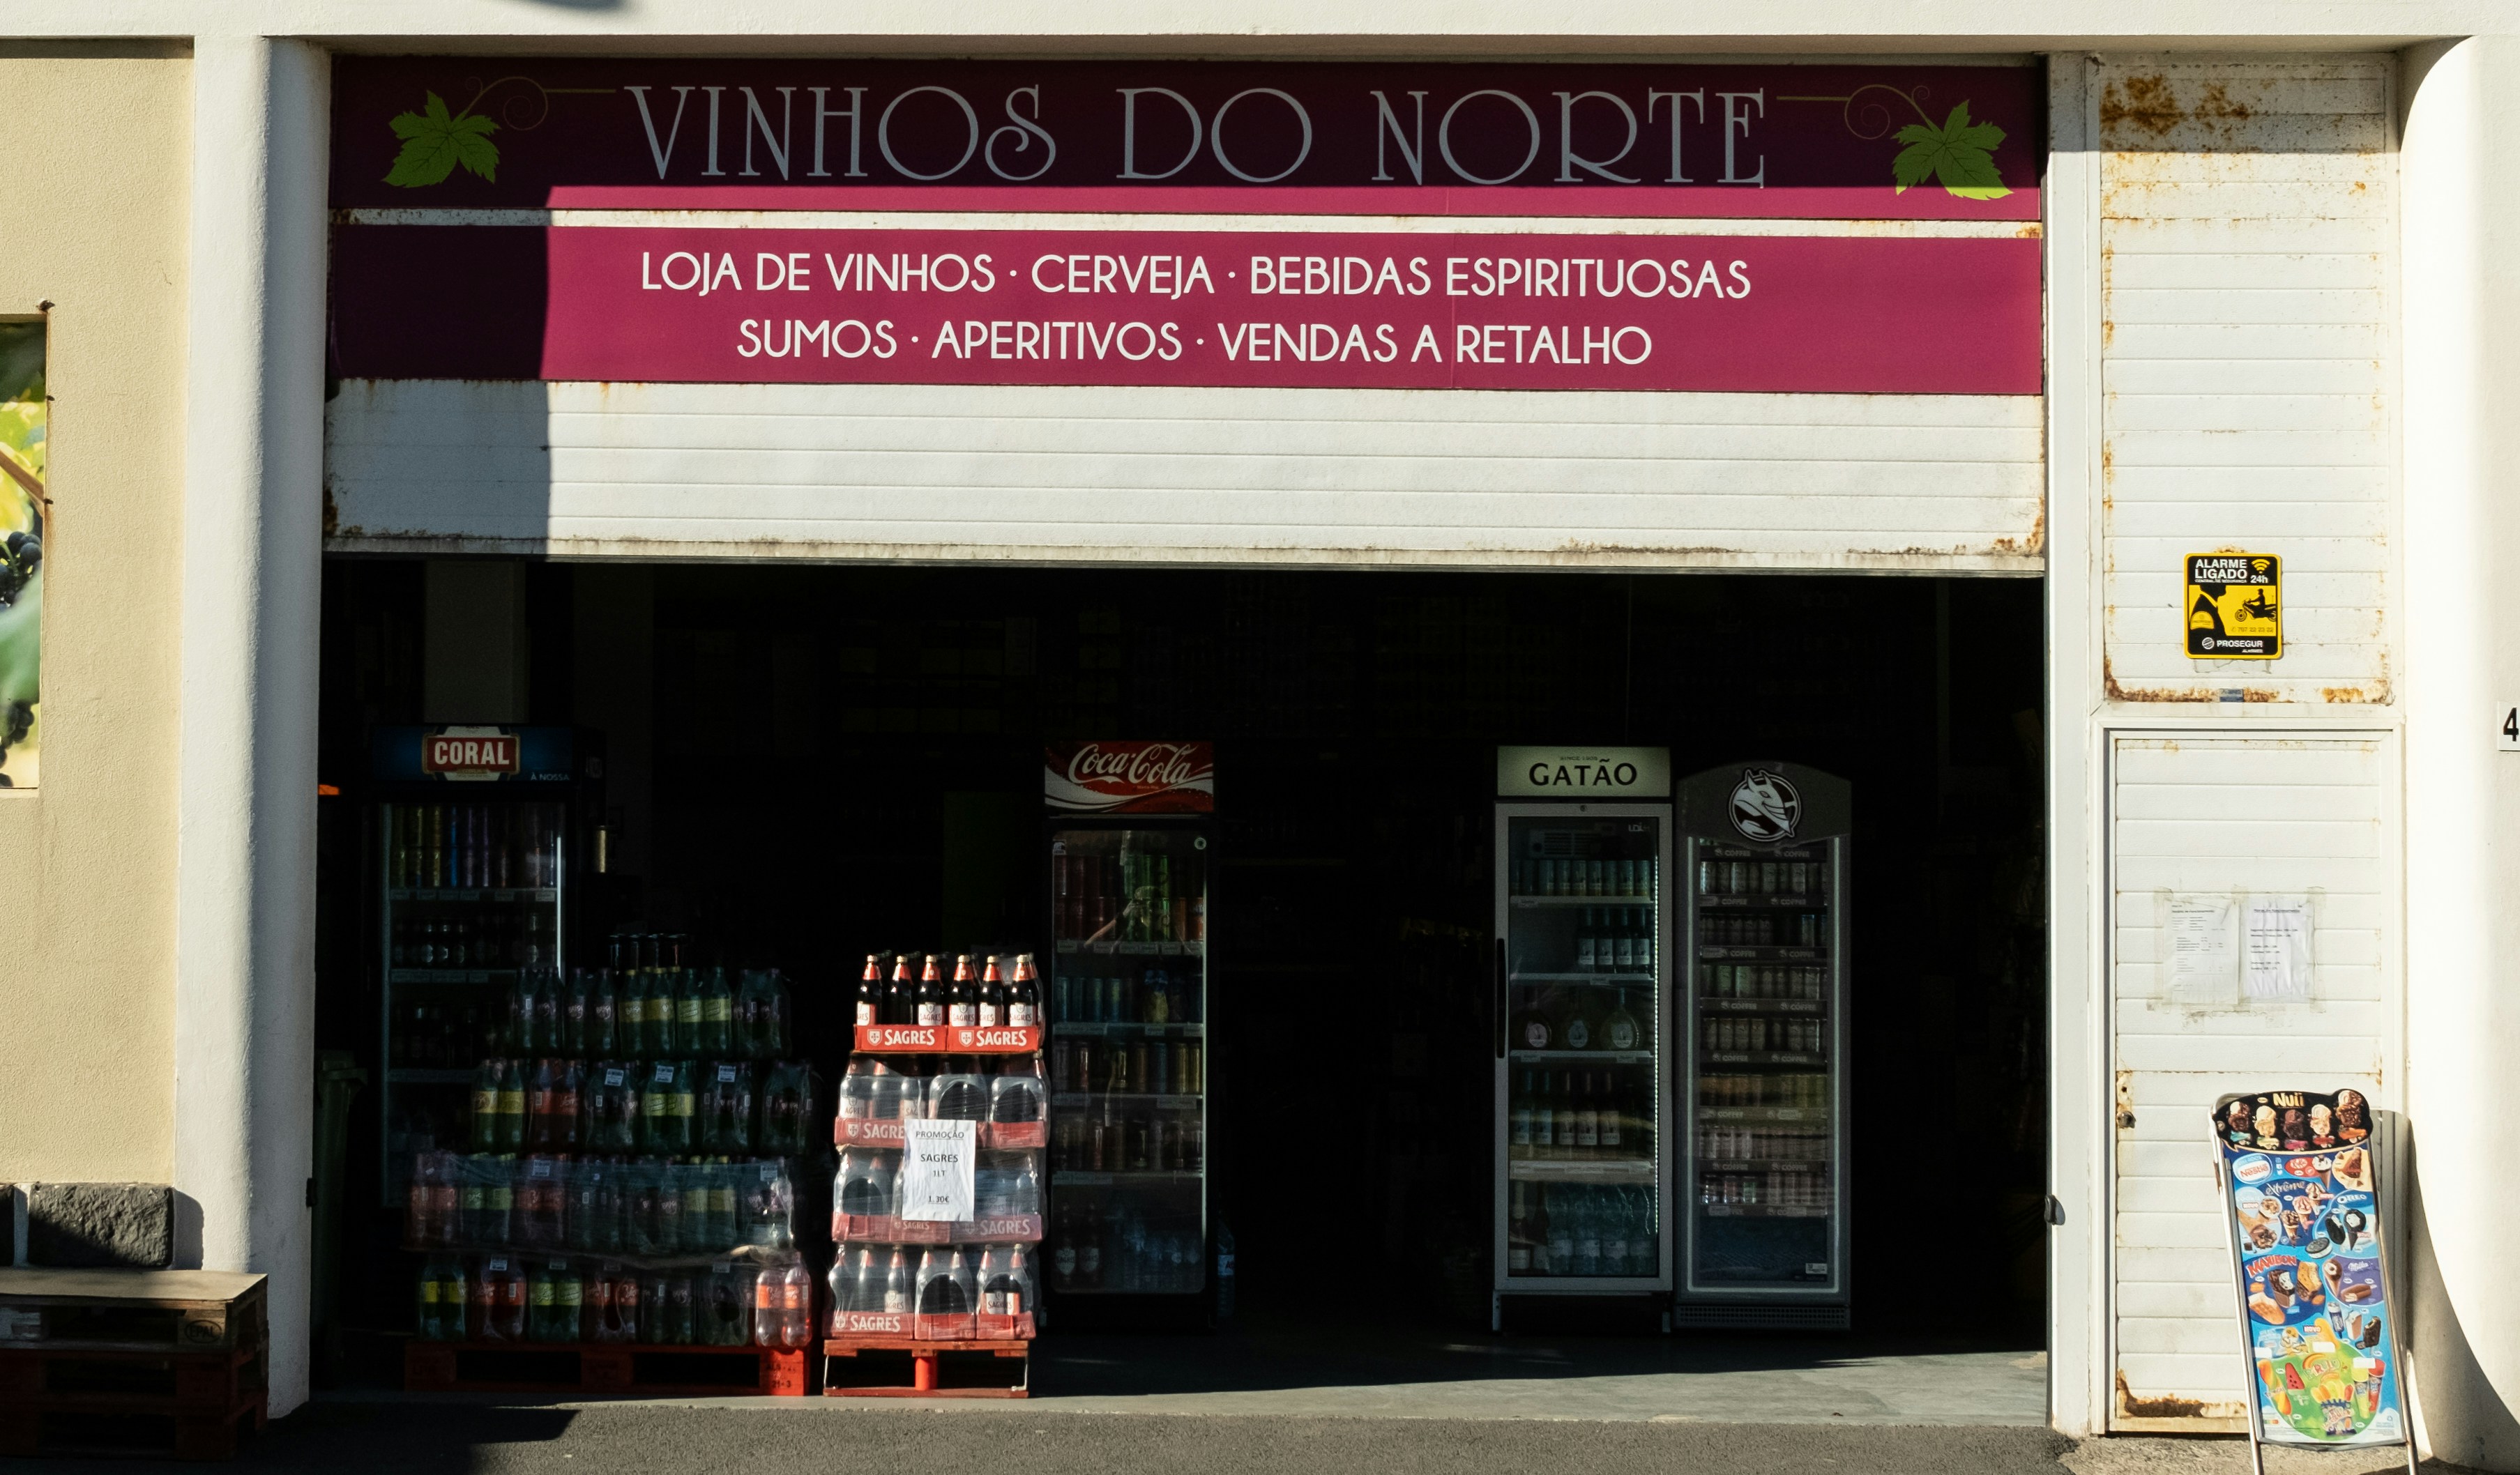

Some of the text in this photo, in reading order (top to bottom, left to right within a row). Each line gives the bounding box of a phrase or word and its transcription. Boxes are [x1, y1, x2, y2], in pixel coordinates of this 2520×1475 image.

[623, 84, 1765, 189] VINHOS DO NORTE
[642, 252, 1751, 300] LOJA DE VINHOS CERVEJA BEBIDAS ESPIRITUOSAS
[737, 319, 1652, 365] SUMOS APERITIVOS VENDAS A RETALHO
[2196, 559, 2247, 568] ALARME
[2195, 569, 2247, 579] LIGADO
[2250, 575, 2268, 583] 24h
[434, 741, 510, 765] CORAL
[1068, 743, 1199, 785] Coca-Cola
[1529, 758, 1637, 786] GATÃO
[884, 1029, 935, 1046] SAGRES
[976, 1030, 1027, 1047] SAGRES
[863, 1122, 904, 1139] SAGRE
[916, 1130, 964, 1140] PROMOÇÃO
[920, 1154, 959, 1163] SAGRES
[2337, 1194, 2367, 1205] OREO
[980, 1220, 1031, 1236] SAGRES
[2245, 1255, 2298, 1278] MAXIBON
[850, 1315, 901, 1332] SAGRES
